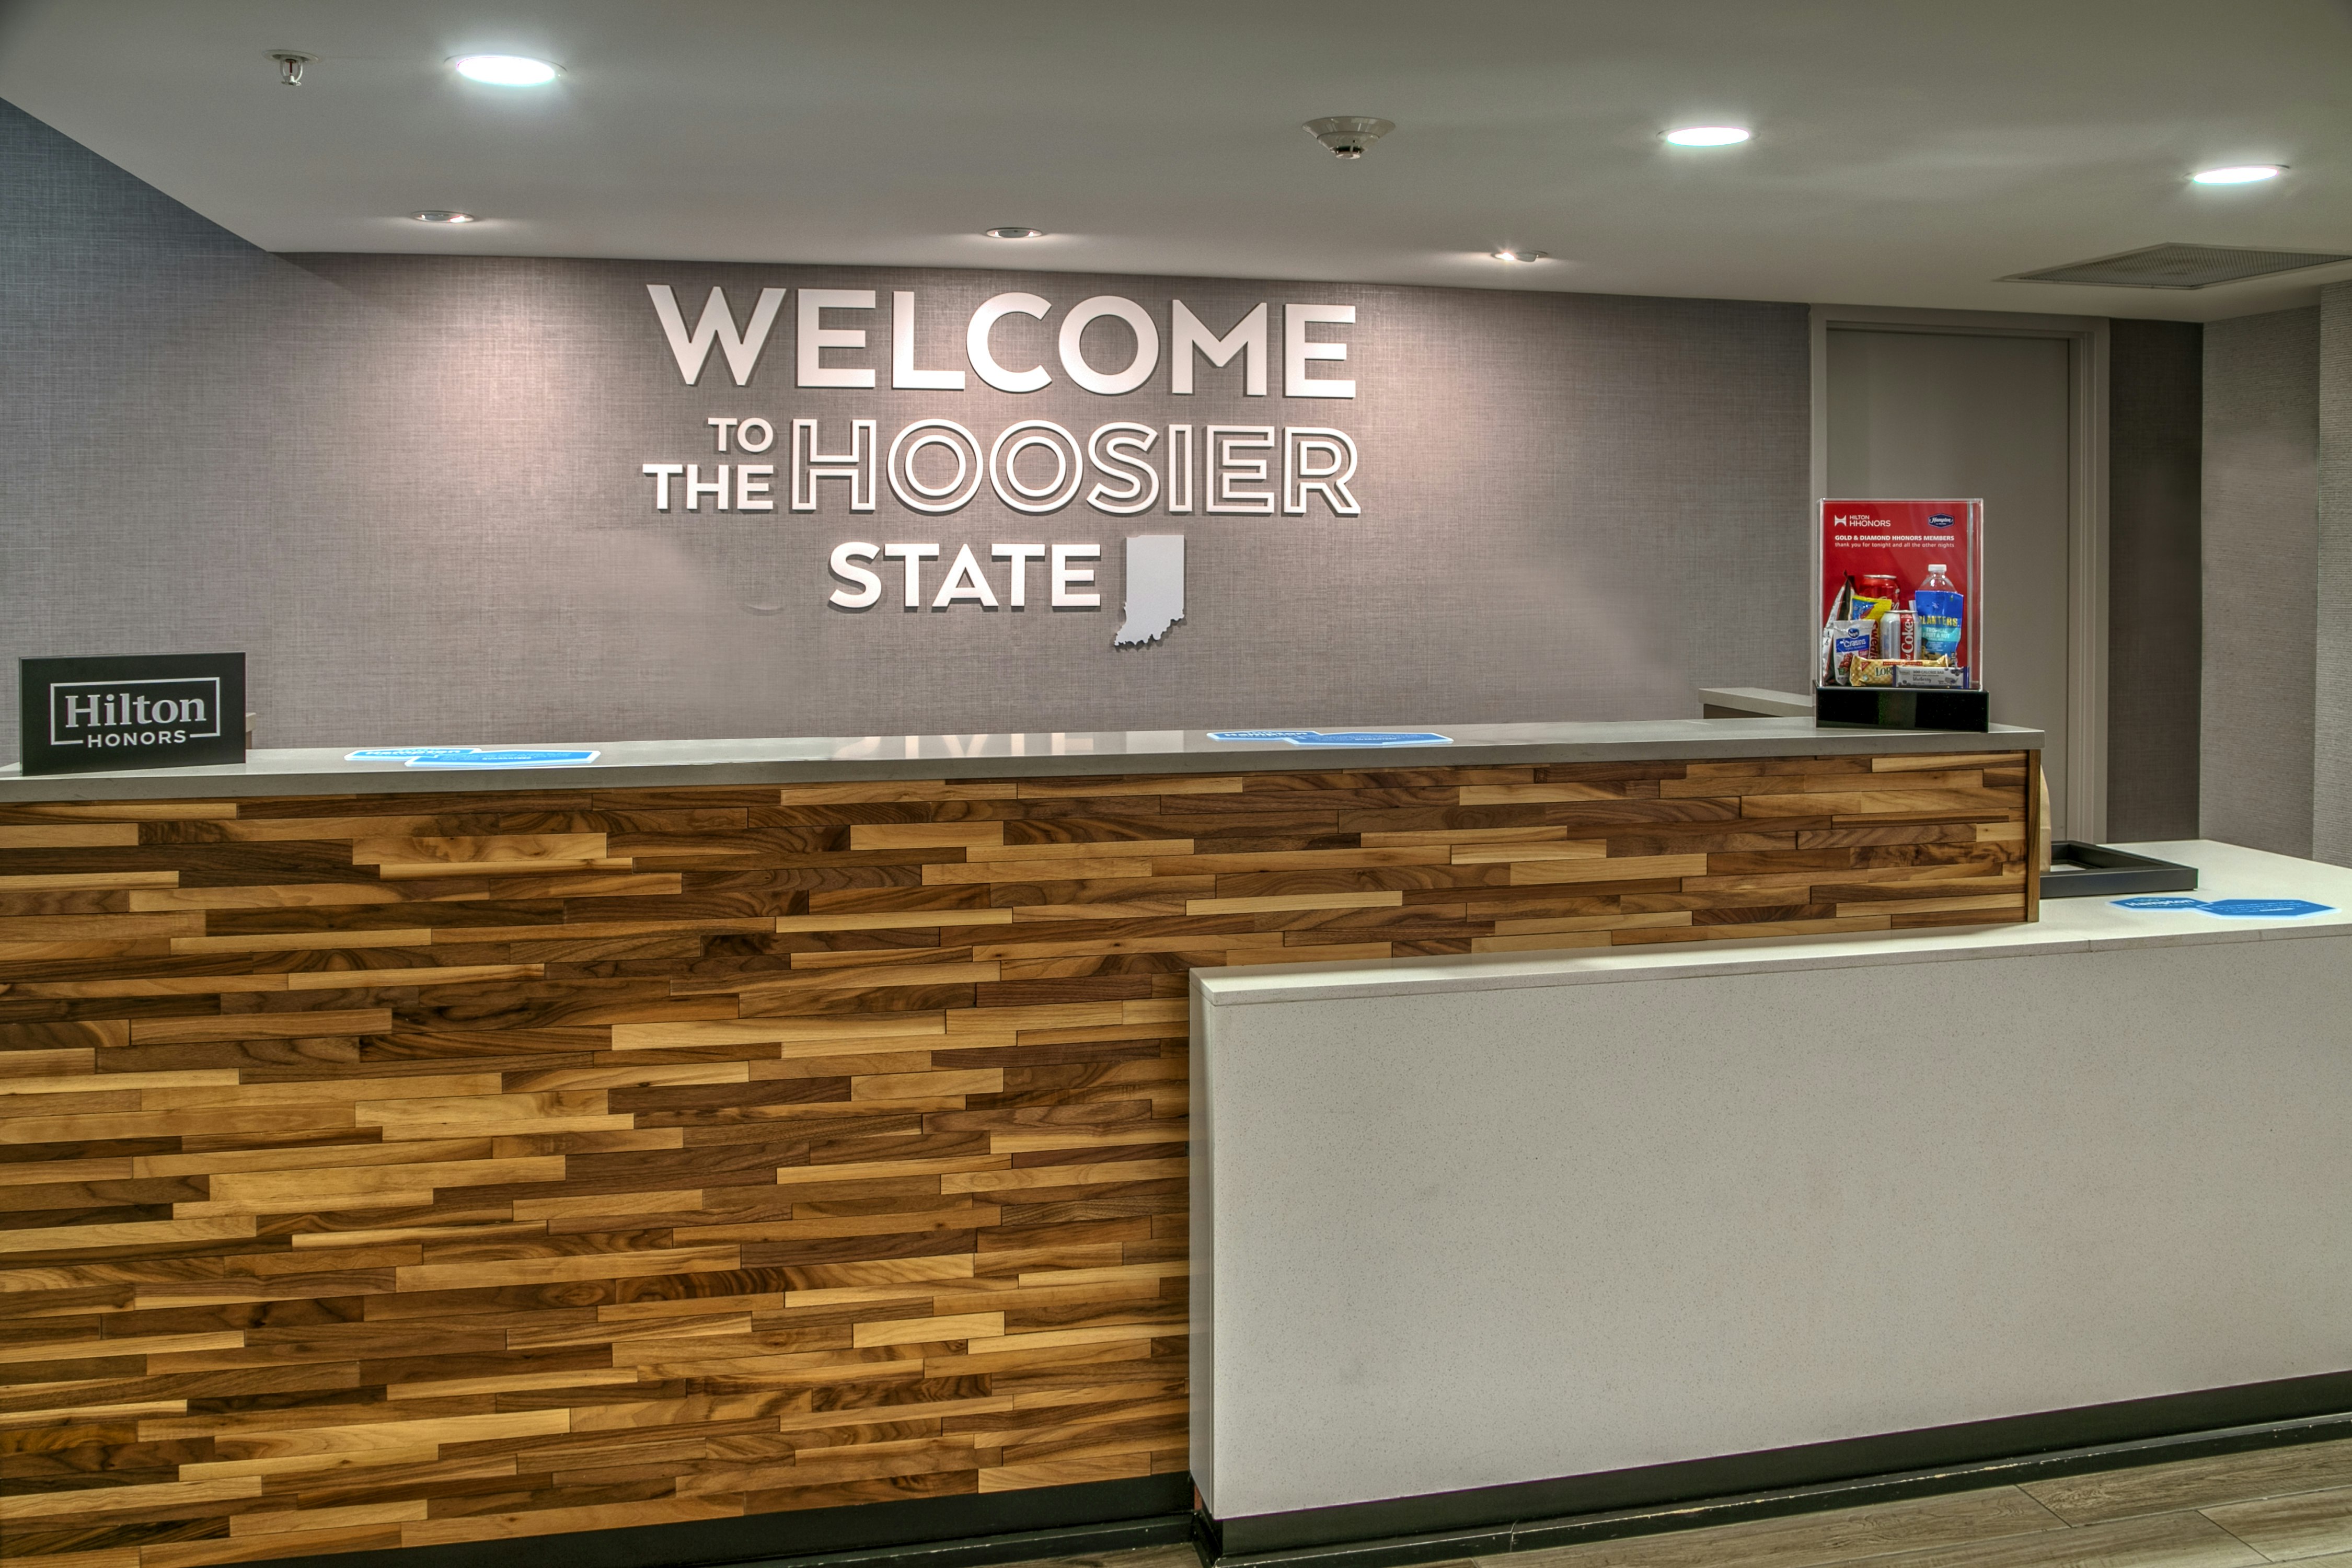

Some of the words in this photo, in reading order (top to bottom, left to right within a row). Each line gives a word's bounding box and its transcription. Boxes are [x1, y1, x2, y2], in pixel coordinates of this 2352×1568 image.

[646, 284, 1356, 398] WELCOME
[707, 418, 774, 453] TO
[642, 464, 775, 511] THE
[792, 419, 1362, 514] HOOSIER
[828, 541, 1101, 608] STATE
[1870, 620, 1879, 660] Swedi
[1901, 621, 1913, 653] Coke
[1875, 667, 1893, 676] LOR
[65, 693, 207, 728] Hilton
[87, 730, 187, 748] HONORS
